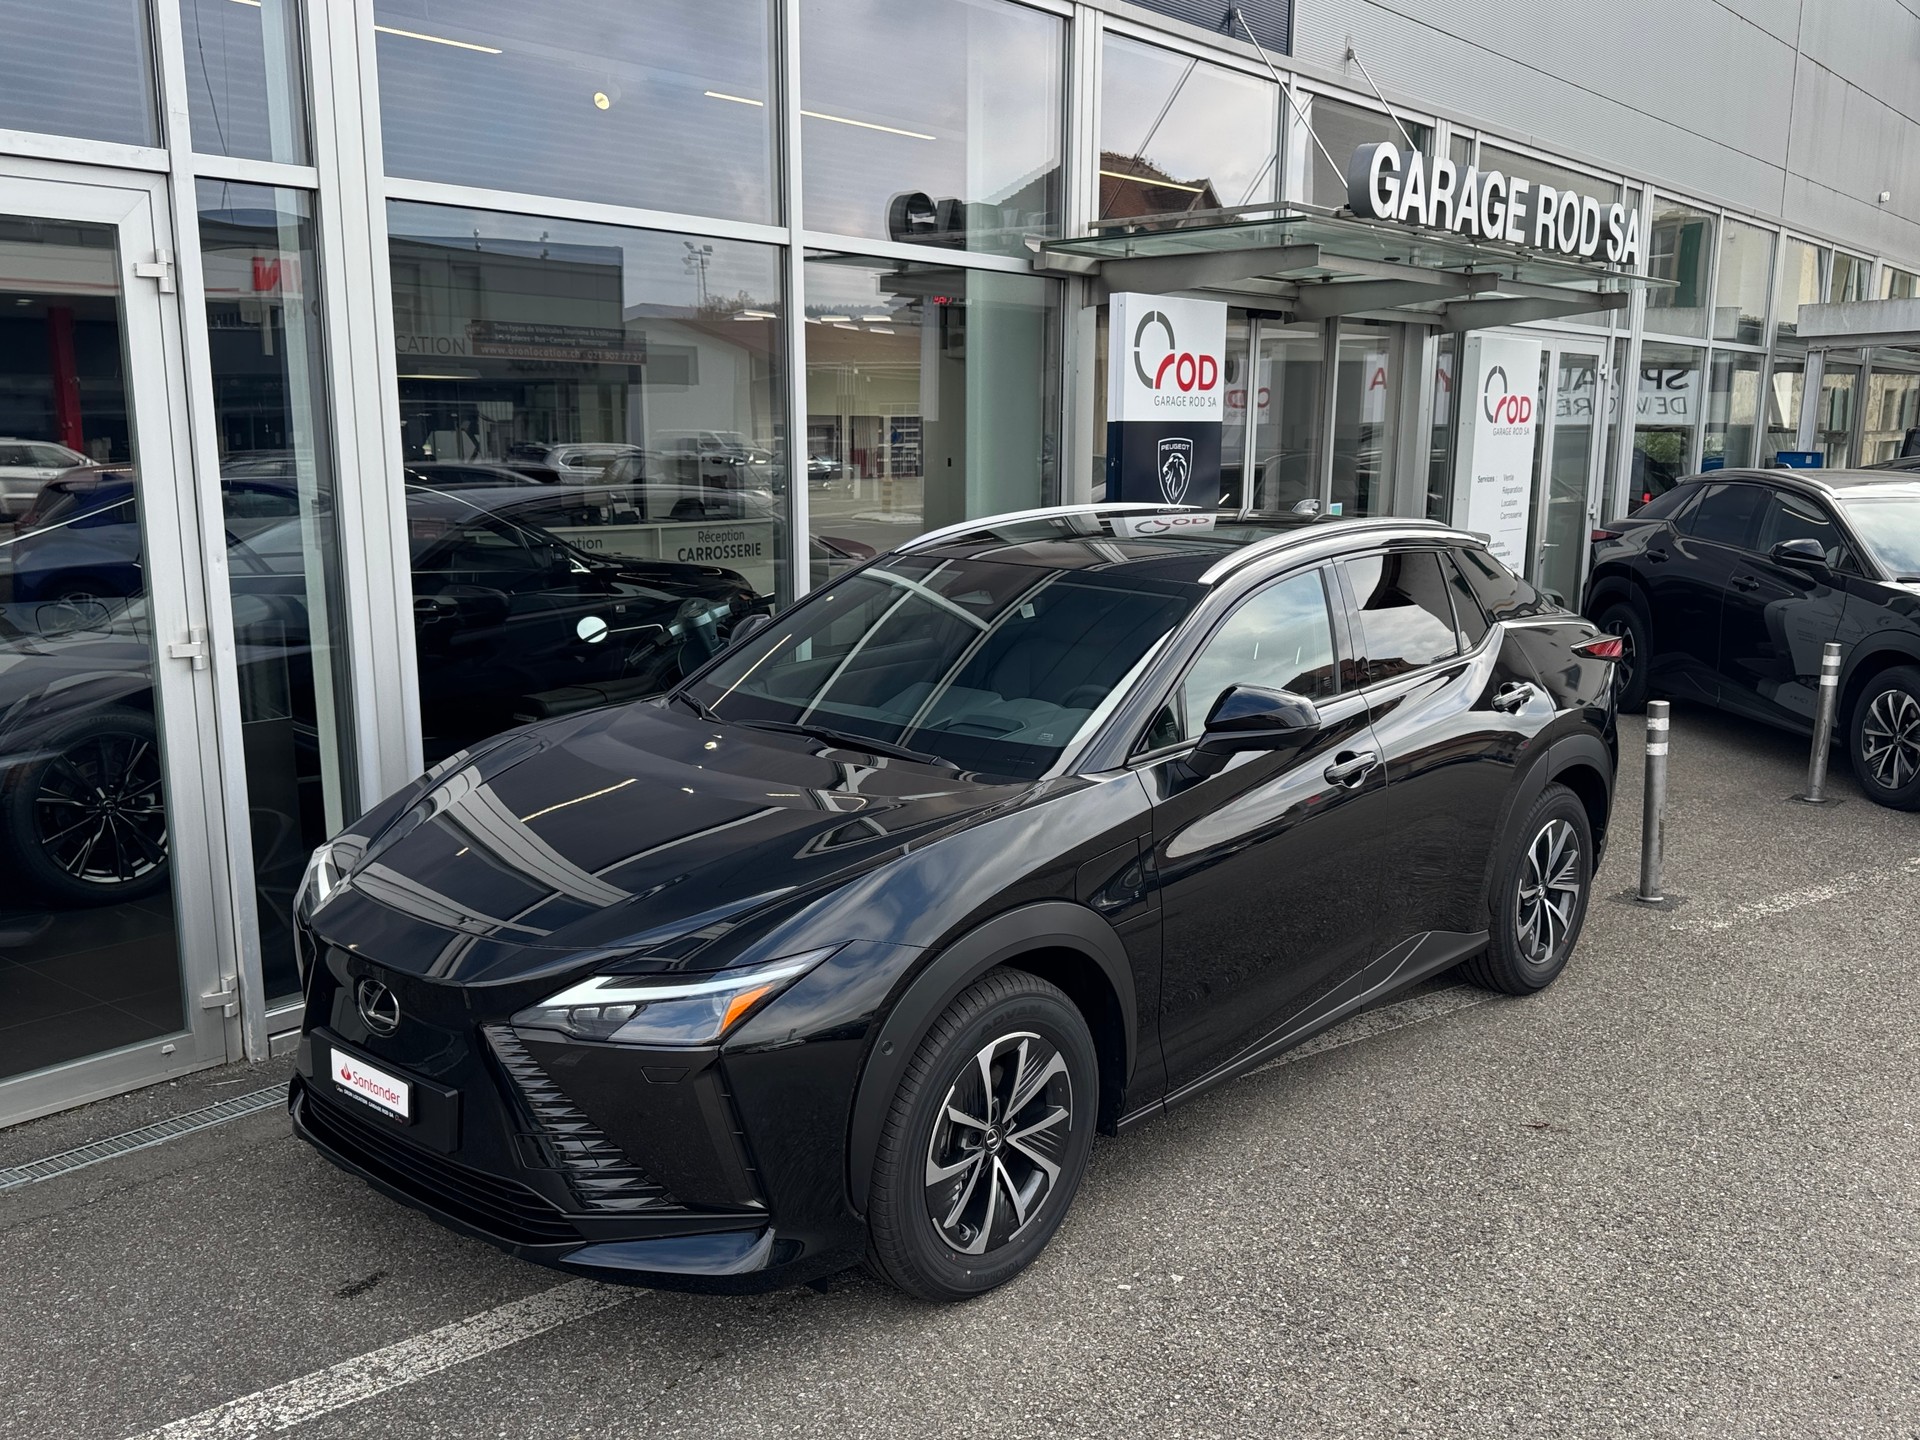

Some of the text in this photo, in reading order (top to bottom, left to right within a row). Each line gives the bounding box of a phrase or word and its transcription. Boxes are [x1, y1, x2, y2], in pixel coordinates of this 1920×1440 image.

[1369, 141, 1639, 265] GARAGE ROD SA
[1153, 395, 1187, 407] GARAGE
[1188, 396, 1206, 407] ROD
[1207, 396, 1217, 407] SA
[1492, 427, 1512, 436] GARAGE
[1512, 427, 1523, 436] ROD
[1160, 443, 1191, 452] PEUGEOT
[697, 529, 745, 544] Réception
[677, 542, 762, 563] CARROSSERIE
[352, 1070, 401, 1105] Santander
